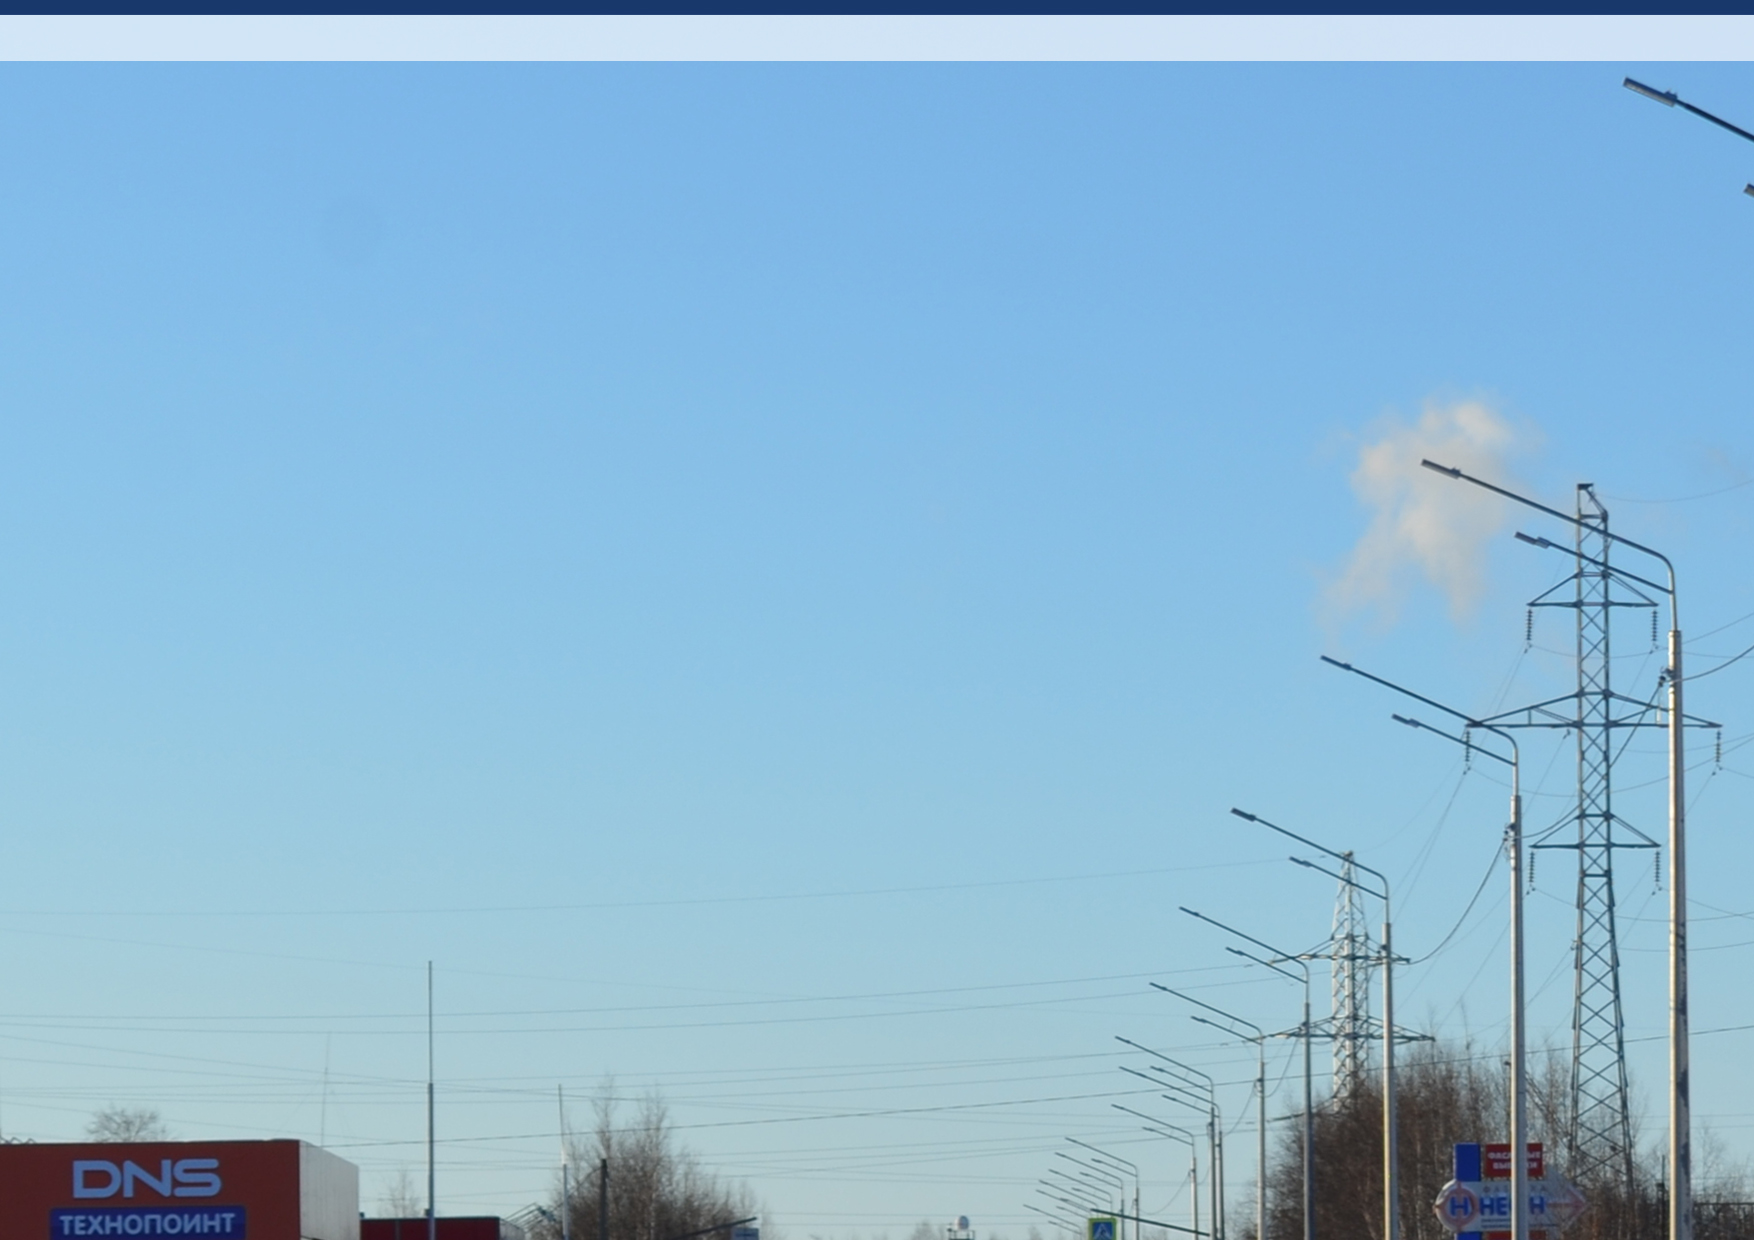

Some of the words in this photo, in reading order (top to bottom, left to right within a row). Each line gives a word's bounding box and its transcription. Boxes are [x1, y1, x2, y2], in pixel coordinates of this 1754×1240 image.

[72, 1158, 222, 1198] DNS
[1480, 1196, 1545, 1216] НЕН
[59, 1213, 235, 1235] ТЕХНОПОИНТ
